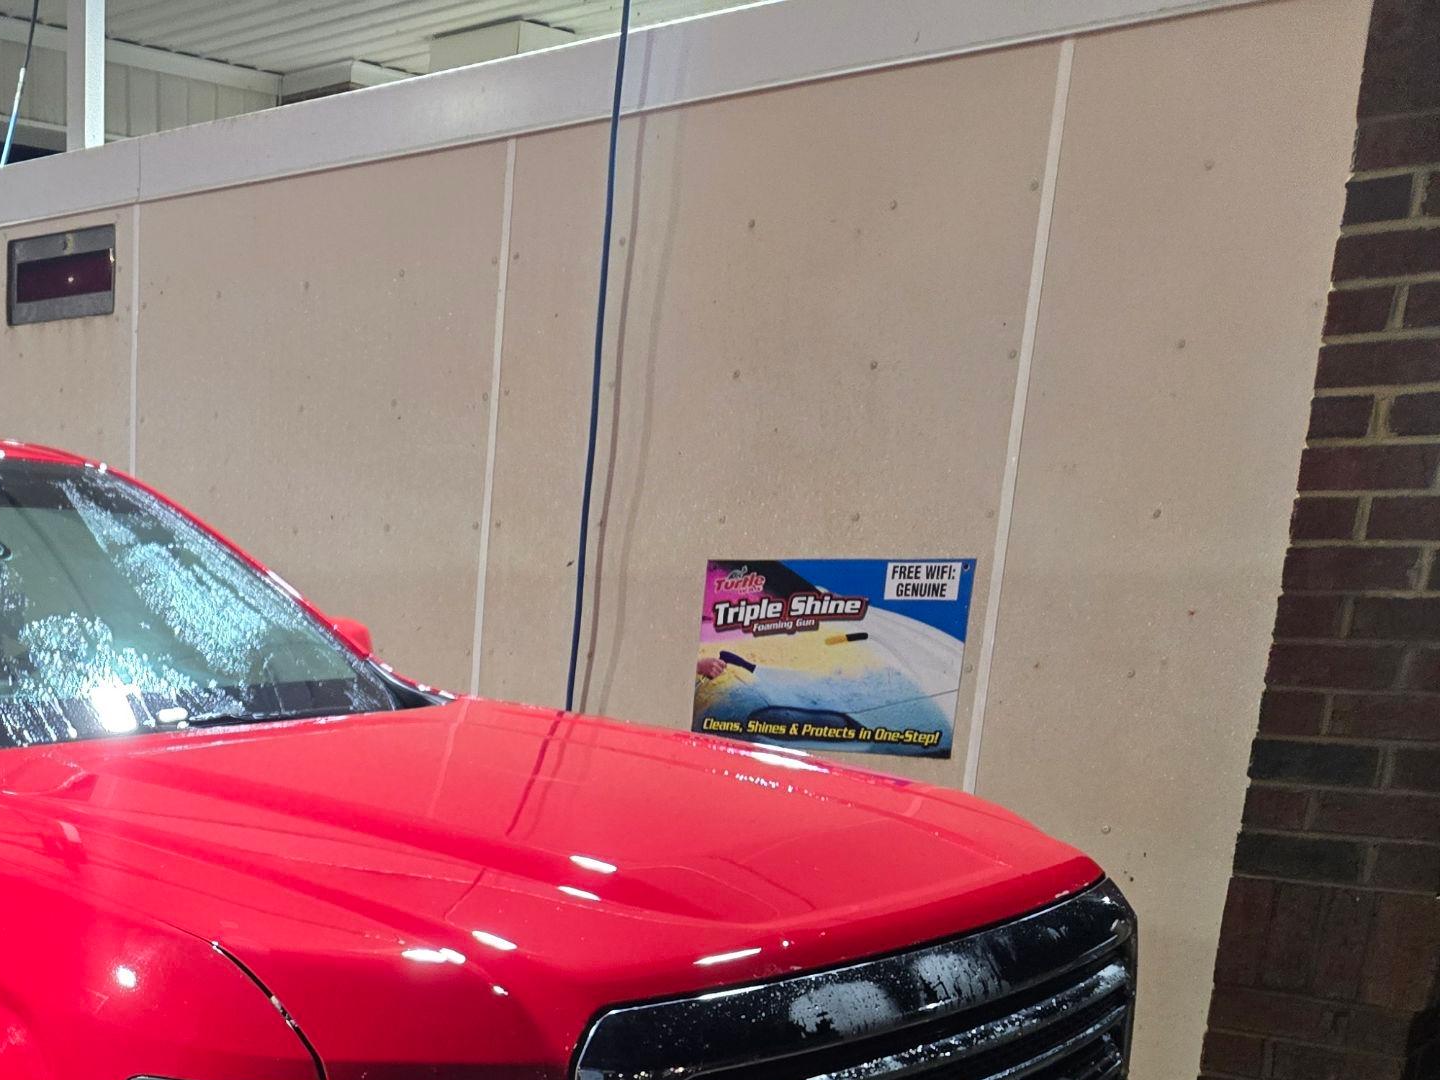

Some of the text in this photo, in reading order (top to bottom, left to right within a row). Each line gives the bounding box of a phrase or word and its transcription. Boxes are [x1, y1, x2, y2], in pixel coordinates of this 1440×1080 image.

[891, 565, 956, 580] FREE WIFI:
[715, 572, 765, 592] Turtle
[896, 583, 947, 598] GENUINE
[715, 595, 862, 627] Triple Shine
[752, 618, 815, 632] Foaming Gun
[702, 717, 743, 732] Cleans,
[746, 720, 786, 734] Shines
[788, 723, 800, 736] &
[801, 724, 856, 739] Protects
[874, 728, 941, 746] One-Step!
